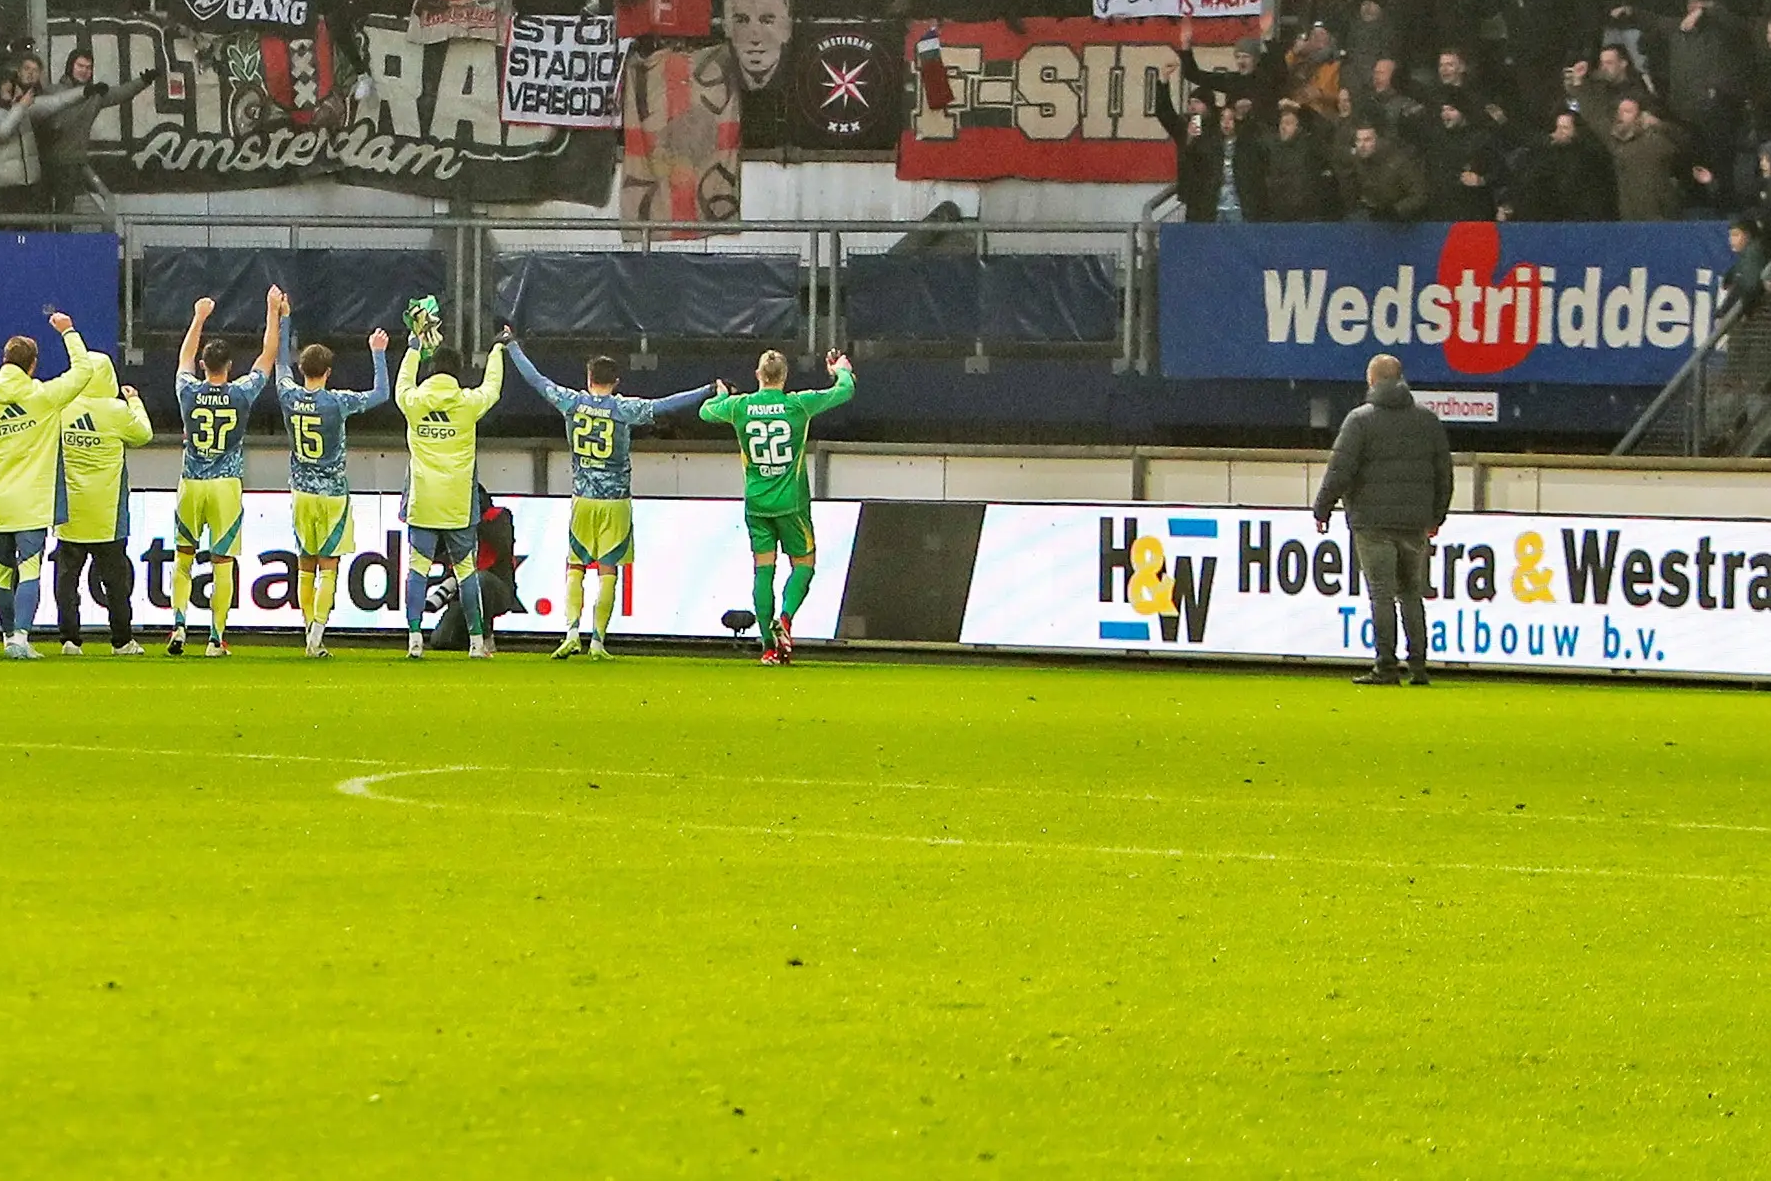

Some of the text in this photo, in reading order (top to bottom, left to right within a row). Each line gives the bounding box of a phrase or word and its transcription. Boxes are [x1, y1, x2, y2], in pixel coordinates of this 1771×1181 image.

[132, 122, 468, 183] Amsterdam
[191, 408, 238, 450] 37
[293, 401, 316, 412] BAAS
[747, 403, 785, 416] PASVEER
[290, 414, 324, 459] 15
[573, 412, 615, 459] 23
[745, 420, 794, 465] 22
[1099, 517, 1218, 643] H&W
[1511, 531, 1556, 605] &
[1603, 616, 1665, 662] b.v.
